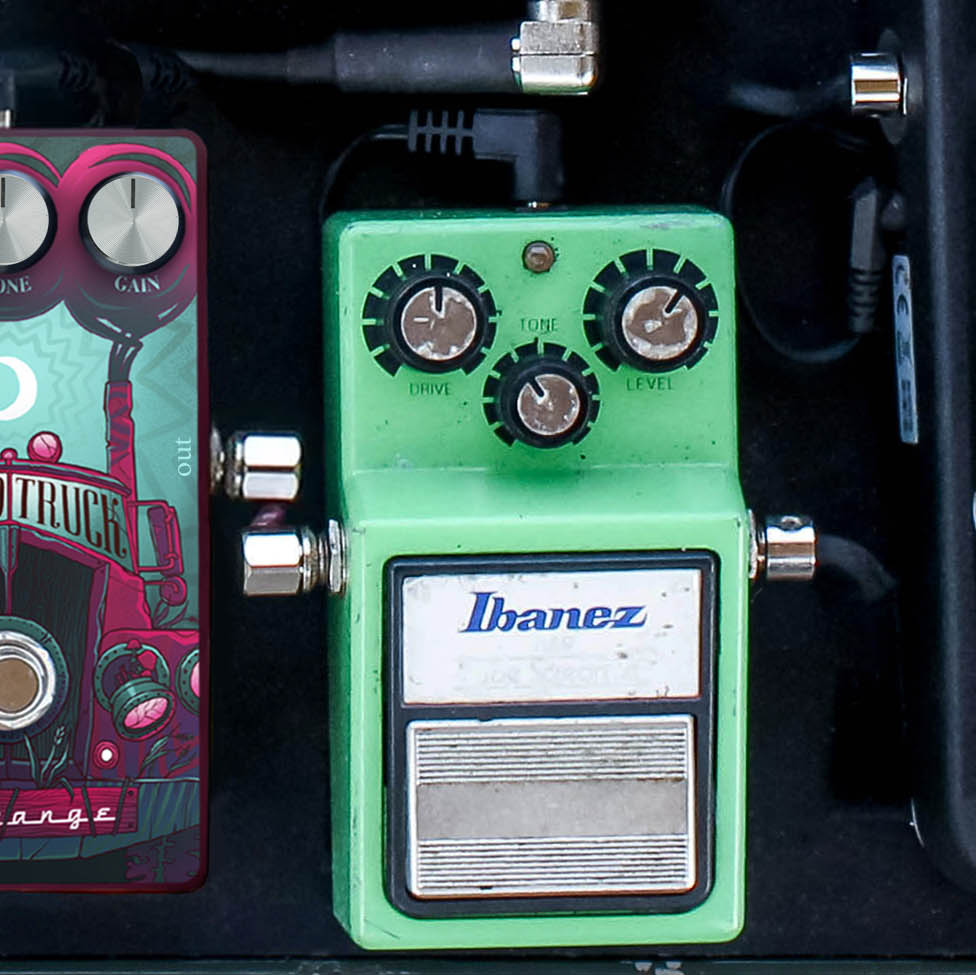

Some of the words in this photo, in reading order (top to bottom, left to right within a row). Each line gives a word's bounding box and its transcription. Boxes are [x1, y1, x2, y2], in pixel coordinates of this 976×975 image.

[114, 276, 161, 293] GAIN
[520, 318, 558, 332] TONE
[410, 381, 451, 396] DRIVE
[626, 377, 673, 391] LEVEL
[177, 437, 193, 477] out
[16, 477, 126, 557] TRUCK
[458, 591, 648, 633] Ibanez
